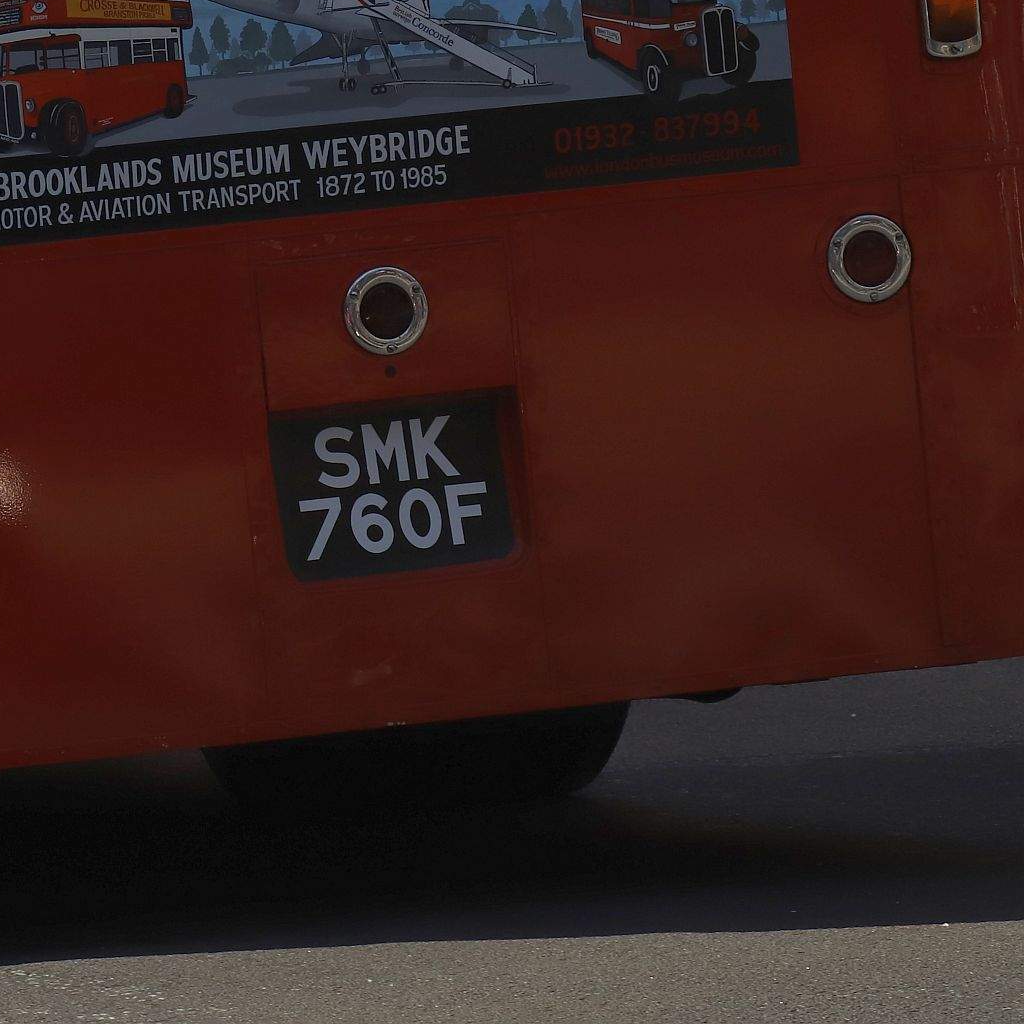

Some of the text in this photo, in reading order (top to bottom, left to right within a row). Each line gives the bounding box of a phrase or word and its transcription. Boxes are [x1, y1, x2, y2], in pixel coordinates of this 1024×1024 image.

[411, 16, 455, 47] Concorde
[171, 143, 291, 184] MUSEUM
[301, 124, 471, 170] WEYBRIDGE
[57, 202, 75, 226] &
[79, 192, 172, 223] AVIATION
[178, 179, 301, 212] TRANSPORT
[316, 172, 366, 198] 1872
[370, 169, 395, 192] TO
[400, 164, 448, 189] 1985
[313, 414, 462, 489] SMK
[298, 481, 488, 562] 760F
